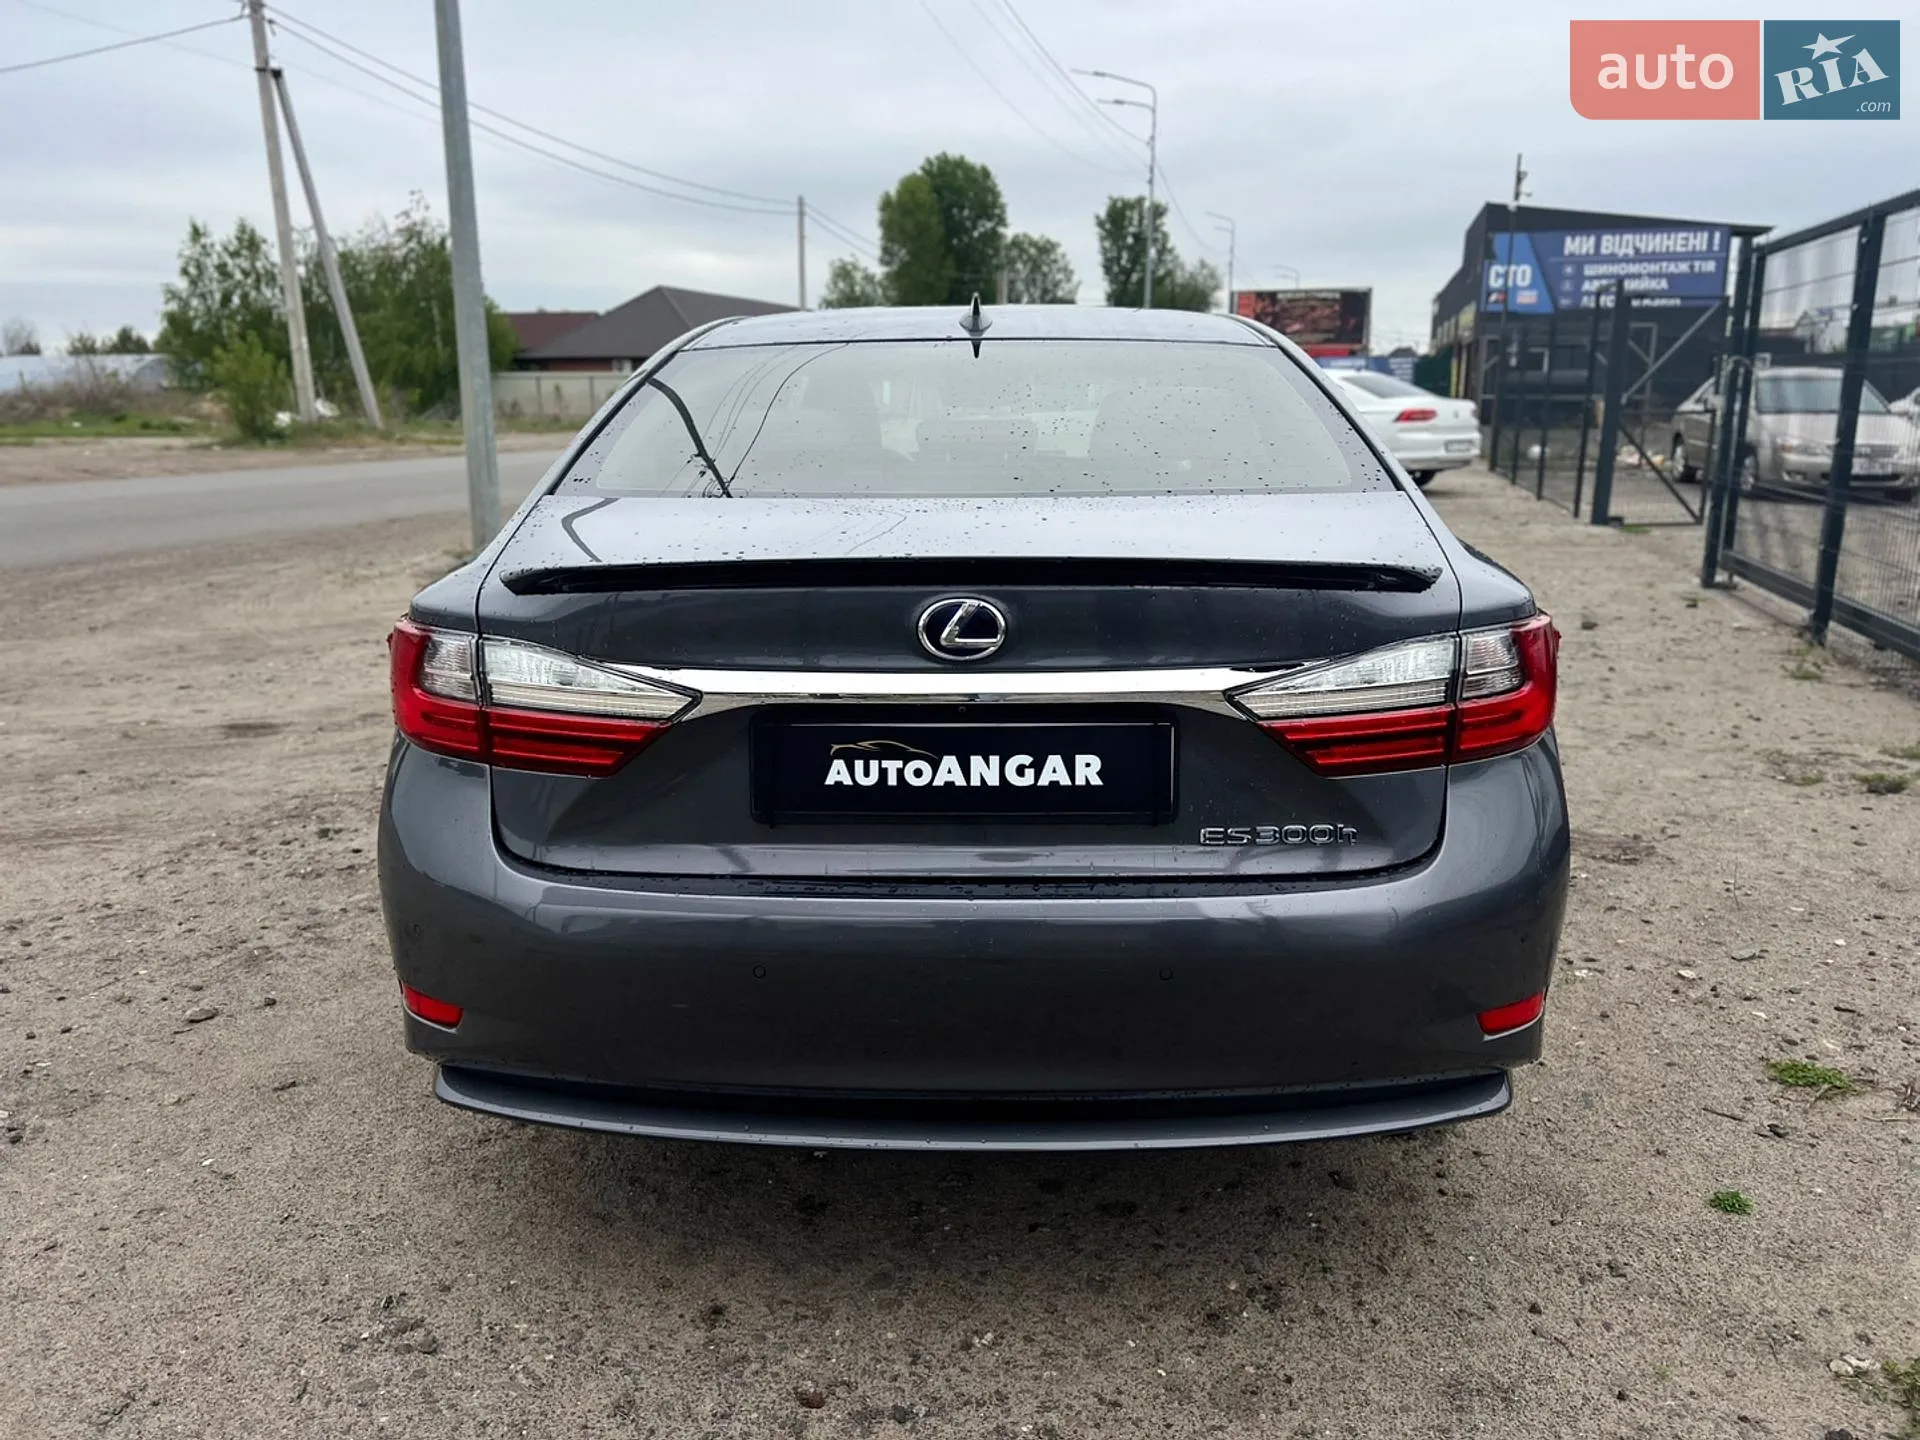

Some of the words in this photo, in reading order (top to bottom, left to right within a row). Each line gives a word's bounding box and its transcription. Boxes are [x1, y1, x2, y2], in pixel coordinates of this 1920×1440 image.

[1564, 234, 1596, 256] МИ
[1600, 231, 1709, 258] ВІДЧИНЕНІ
[1488, 264, 1533, 289] СТО
[1583, 261, 1691, 277] ШИНОМОНТАЖ
[1581, 276, 1669, 293] АВТИЙКА
[824, 753, 1104, 787] AUTOANGAR
[1199, 823, 1359, 846] ES300h
